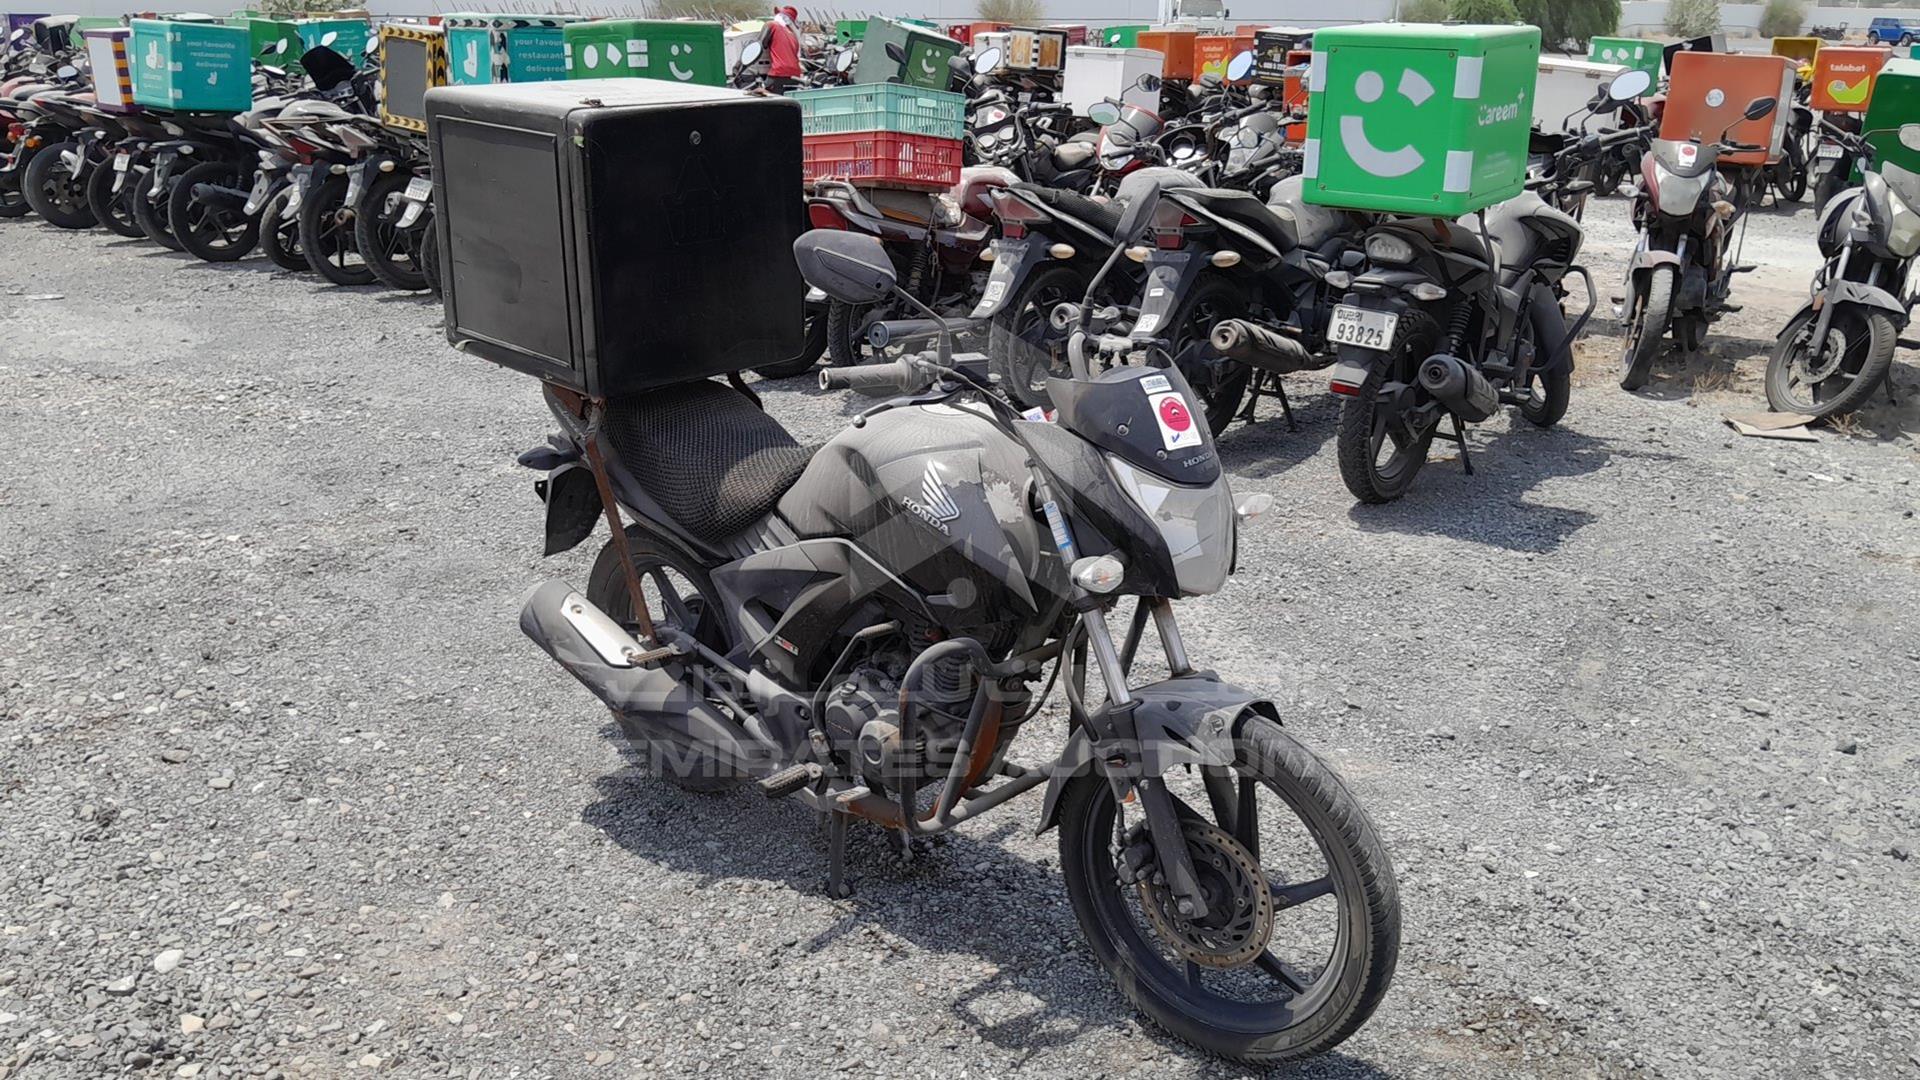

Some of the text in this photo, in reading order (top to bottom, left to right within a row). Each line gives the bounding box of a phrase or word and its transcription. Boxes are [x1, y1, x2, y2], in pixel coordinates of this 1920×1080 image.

[514, 39, 533, 47] your
[1830, 64, 1866, 72] talabat
[1336, 323, 1384, 346] 93825
[902, 496, 950, 536] HONDA
